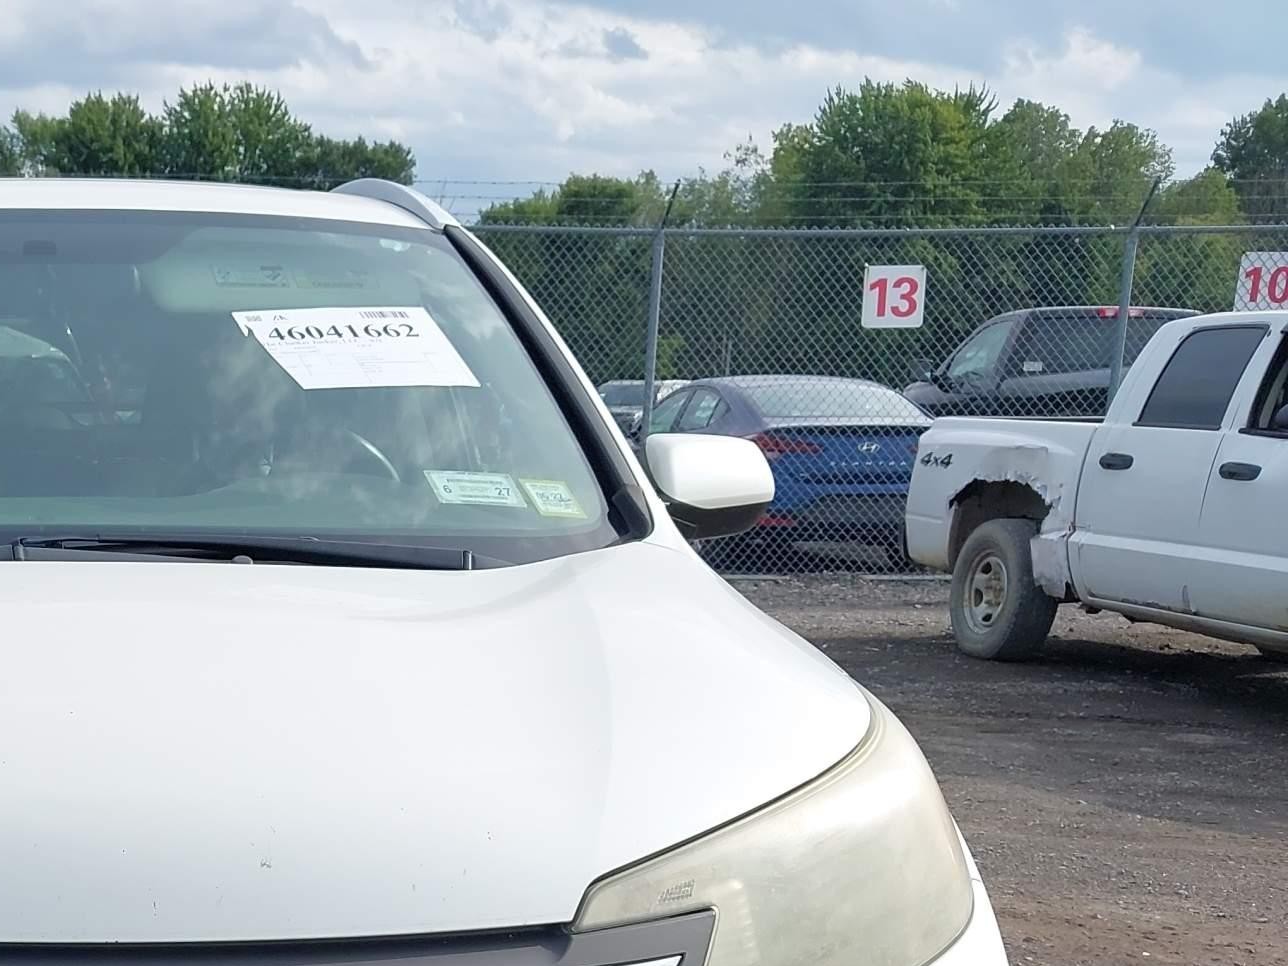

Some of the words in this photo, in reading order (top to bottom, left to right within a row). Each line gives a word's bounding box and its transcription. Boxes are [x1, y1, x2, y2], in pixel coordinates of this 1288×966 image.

[869, 277, 919, 318] 13
[268, 323, 420, 341] 46041662
[920, 451, 954, 469] 4x4
